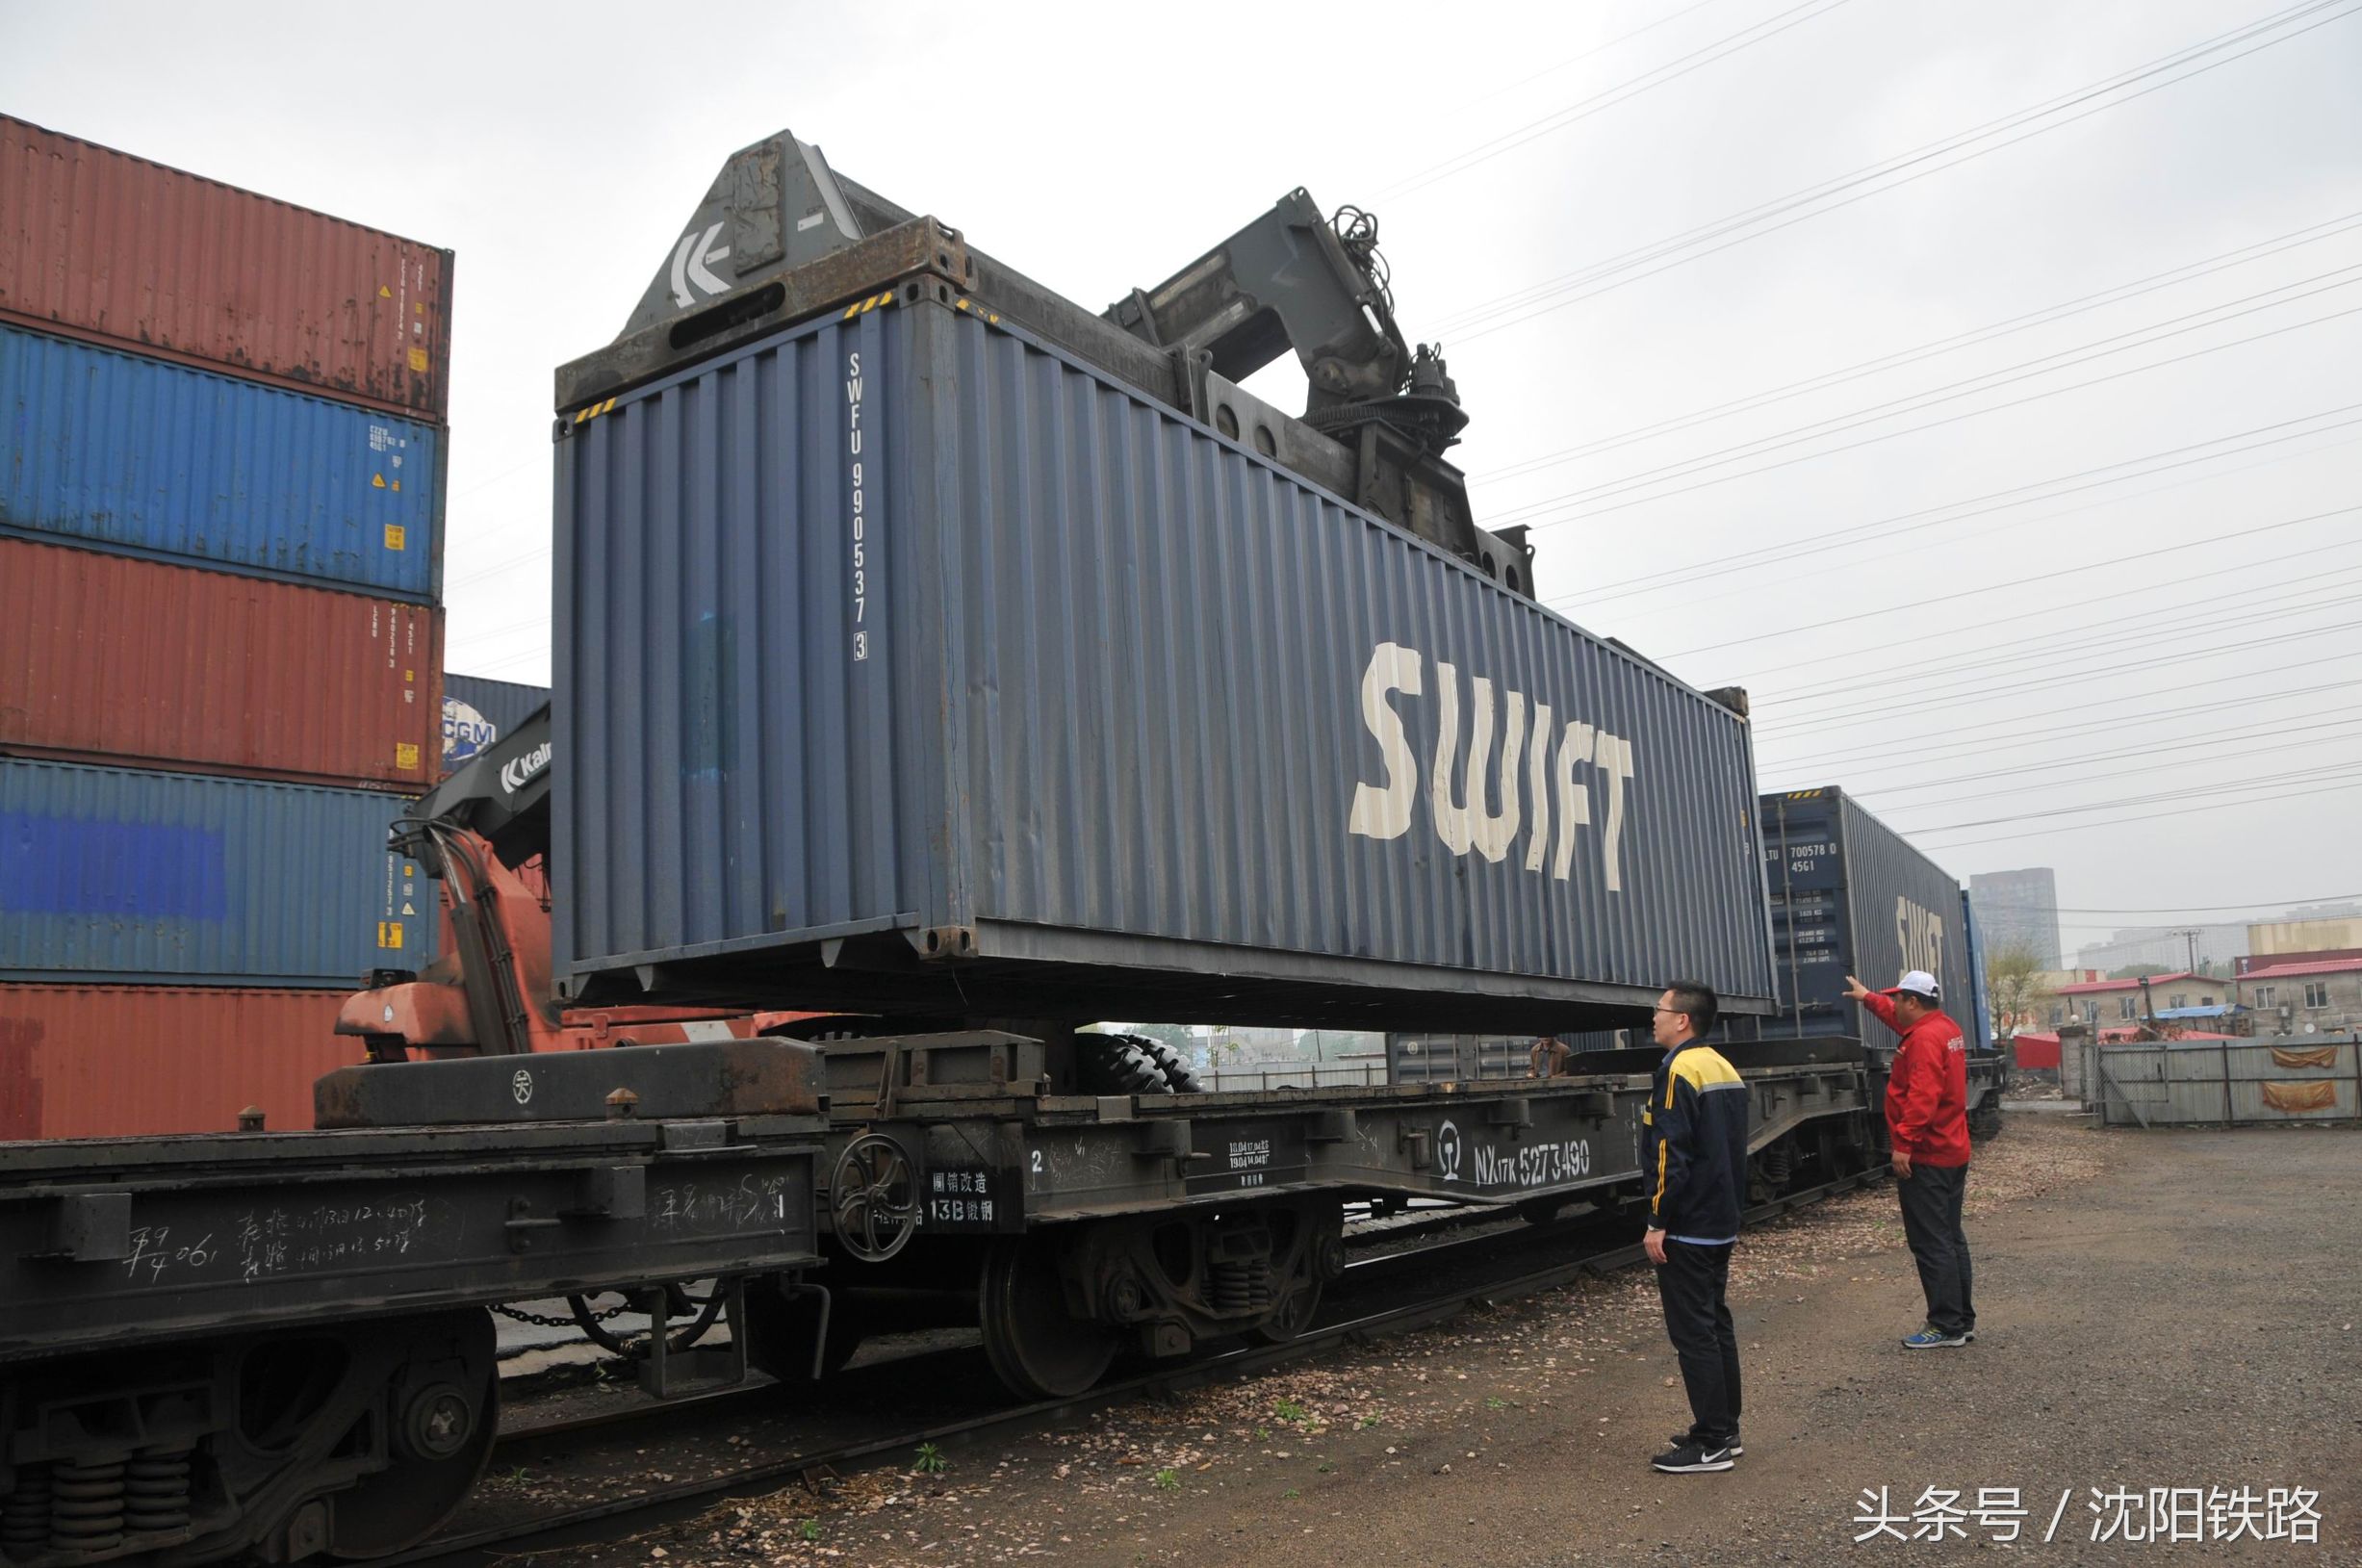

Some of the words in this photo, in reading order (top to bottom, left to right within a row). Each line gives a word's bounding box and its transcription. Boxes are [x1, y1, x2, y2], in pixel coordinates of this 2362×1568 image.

[847, 352, 862, 454] SWFU
[853, 463, 864, 622] 990537
[855, 632, 866, 660] 3
[442, 719, 493, 745] CGM
[1348, 642, 1634, 891] SWIFT
[1790, 844, 1825, 858] 700578
[1791, 860, 1814, 872] 45G1
[1032, 1150, 1042, 1172] 2
[1520, 1139, 1589, 1186] 5273490
